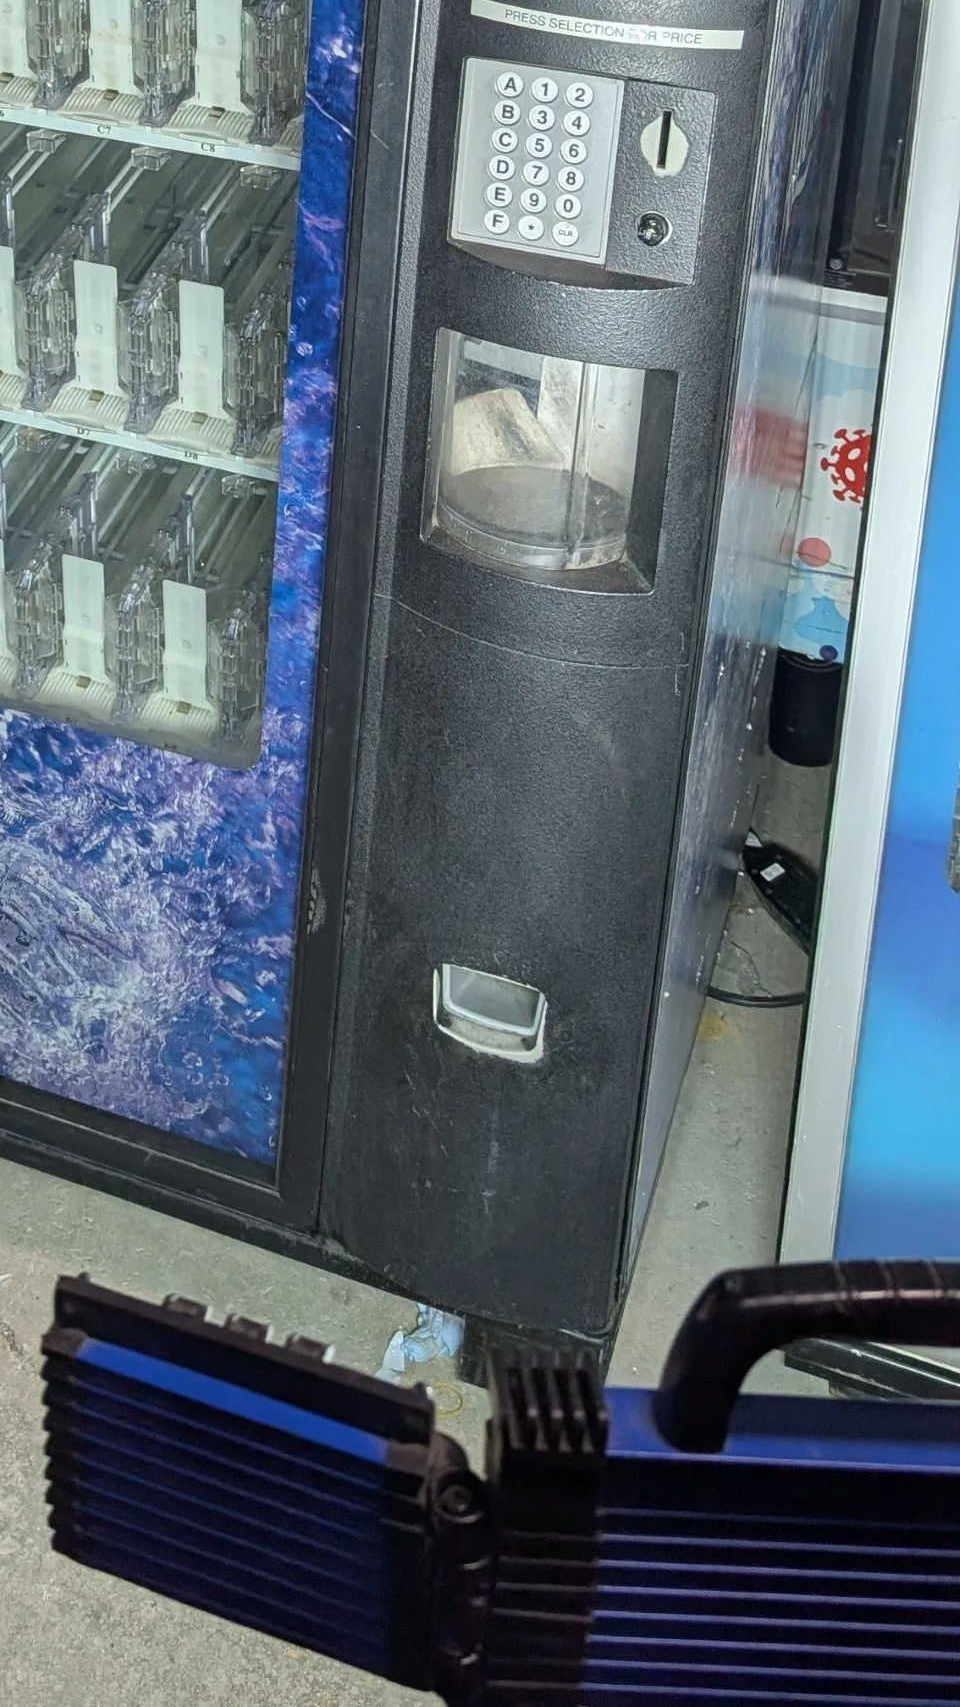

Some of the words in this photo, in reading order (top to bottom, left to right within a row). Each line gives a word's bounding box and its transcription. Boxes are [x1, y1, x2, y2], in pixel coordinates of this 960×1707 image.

[505, 8, 546, 26] PRESS
[549, 18, 625, 38] SELECTION
[504, 77, 517, 92] A
[542, 83, 548, 96] 1
[575, 88, 586, 102] 2
[502, 105, 514, 118] B
[537, 111, 547, 124] 3
[571, 116, 582, 130] 4
[96, 124, 112, 135] C7
[200, 142, 216, 153] C8
[499, 132, 512, 147] C
[534, 139, 544, 152] 5
[568, 144, 579, 158] 6
[496, 160, 509, 174] D
[532, 166, 542, 179] 7
[566, 172, 576, 185] 8
[494, 187, 505, 201] E
[529, 194, 539, 207] 9
[563, 199, 573, 212] 0
[492, 214, 503, 228] F
[558, 229, 573, 237] CLR
[76, 426, 90, 436] D7
[183, 450, 199, 460] D8
